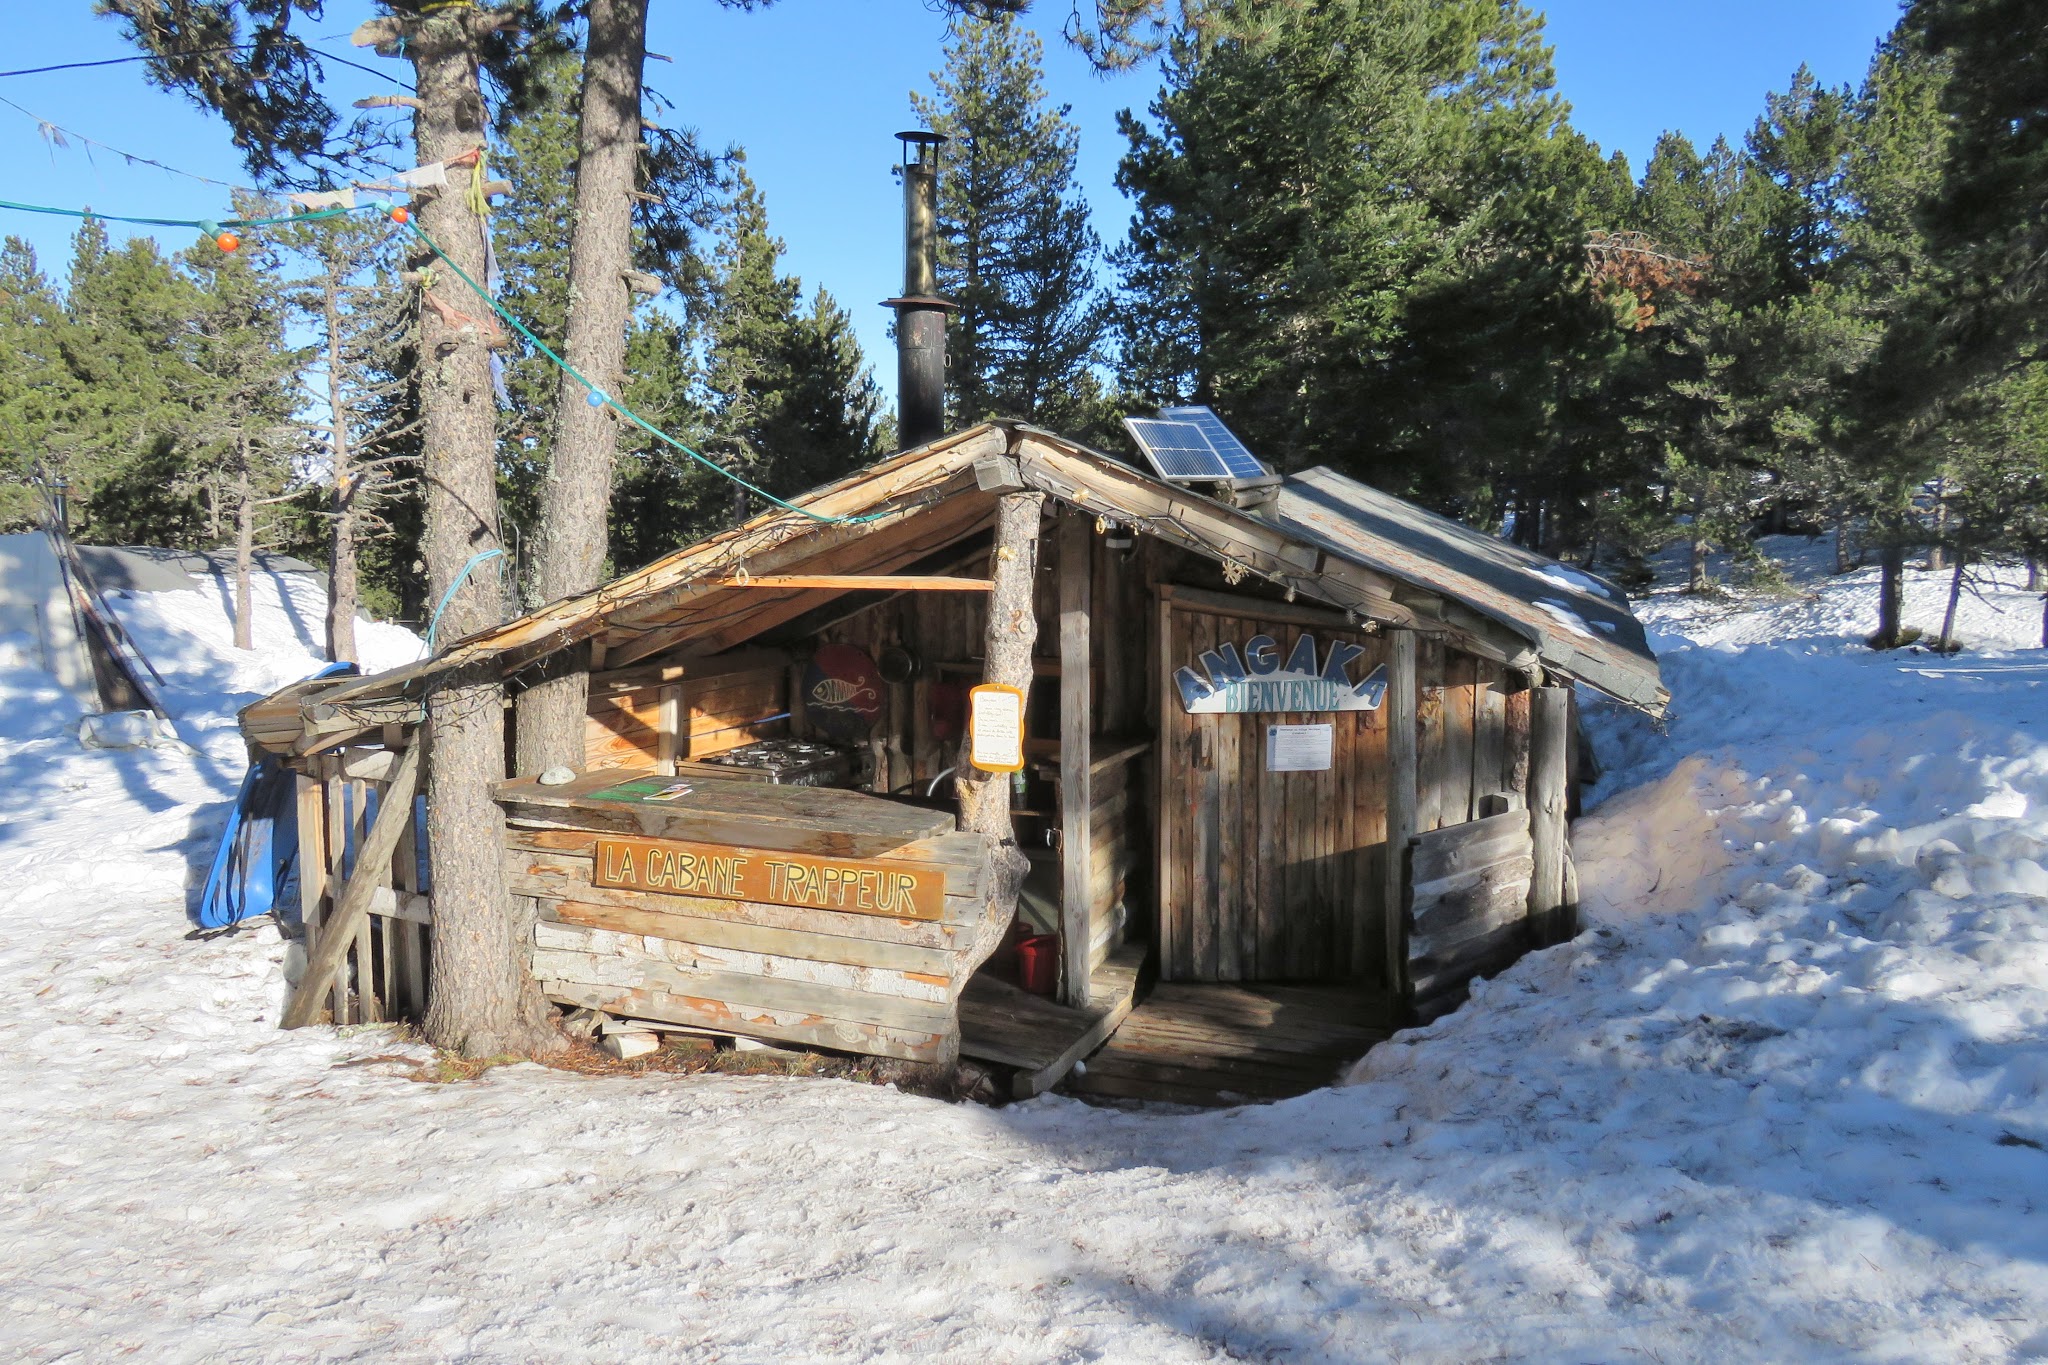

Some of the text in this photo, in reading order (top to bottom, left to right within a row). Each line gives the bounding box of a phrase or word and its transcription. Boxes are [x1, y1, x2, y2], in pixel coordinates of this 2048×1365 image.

[1174, 634, 1387, 710] ANGAKA
[1225, 680, 1340, 712] BIENVENUE
[605, 845, 917, 914] LA CABANE TRAPPEUR
